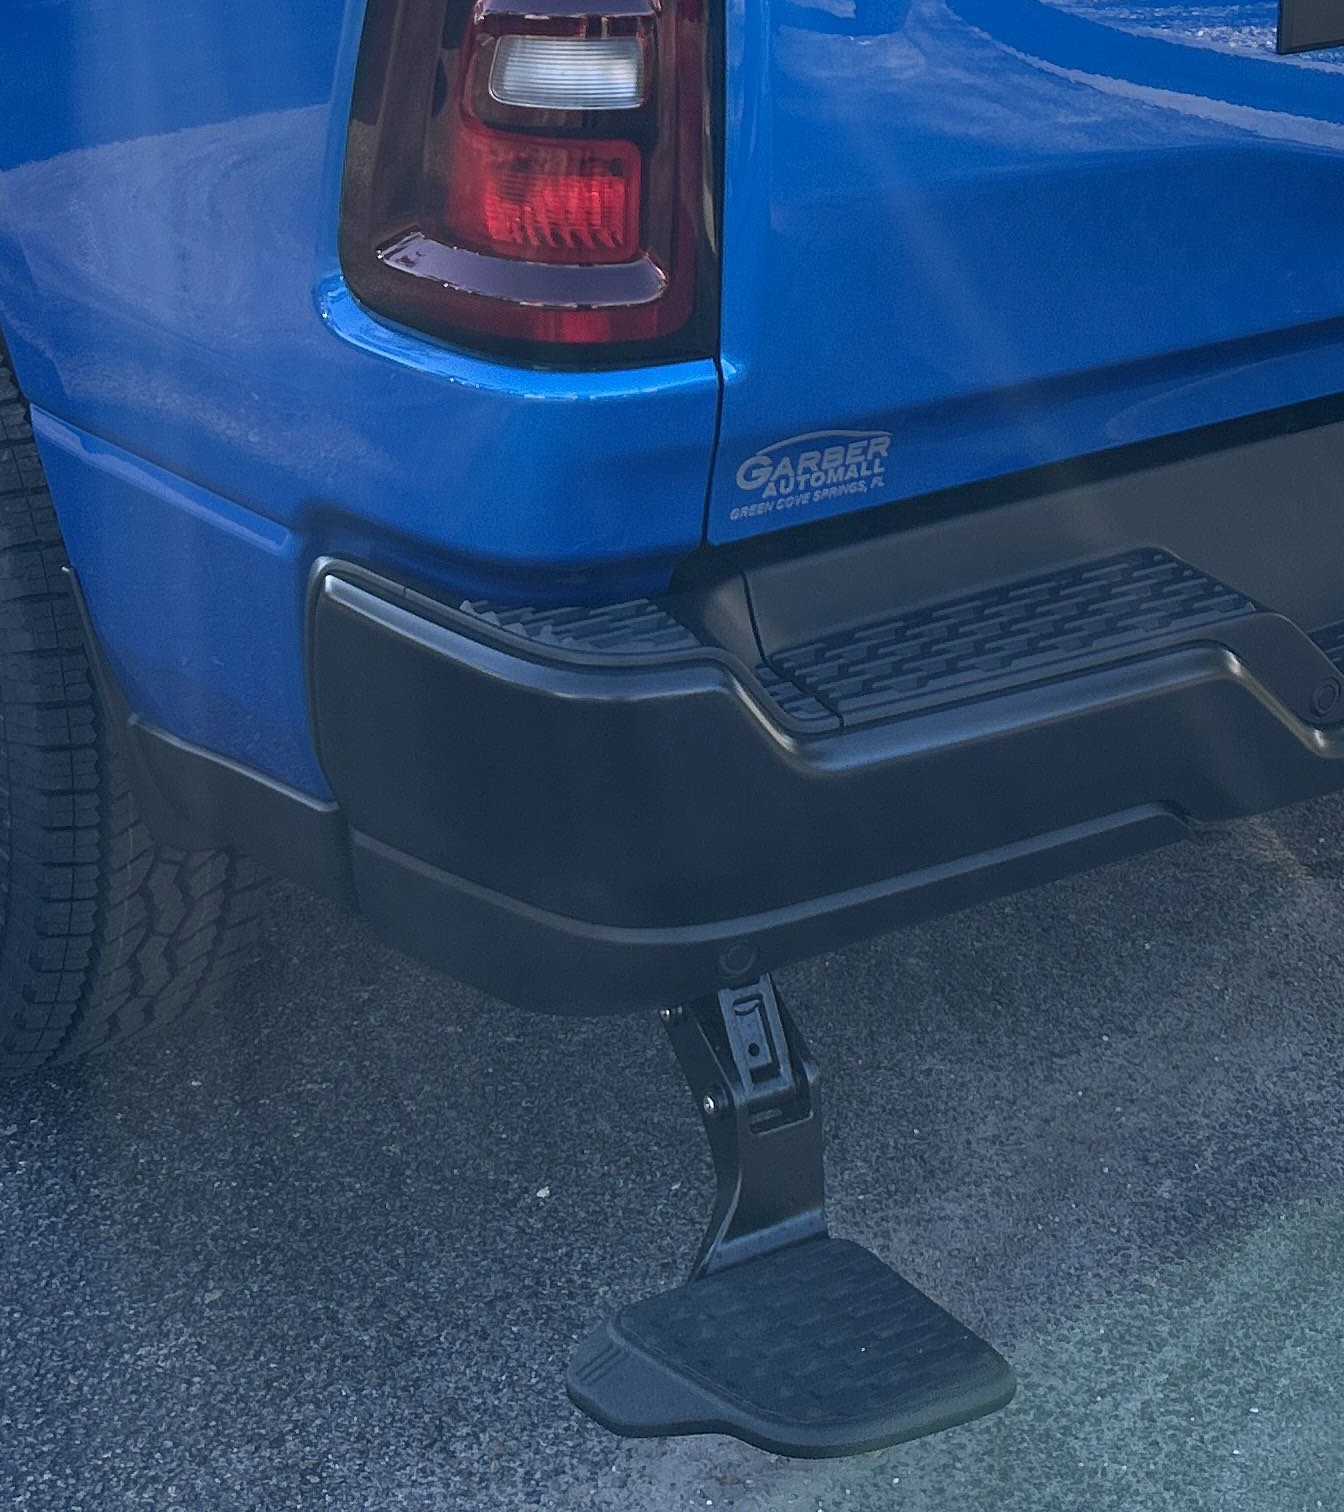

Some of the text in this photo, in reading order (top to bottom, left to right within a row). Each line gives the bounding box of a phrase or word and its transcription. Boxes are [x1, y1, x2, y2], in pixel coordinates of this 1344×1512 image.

[735, 436, 892, 491] GARBER
[761, 458, 886, 499] AUTOMALL
[730, 500, 776, 521] GREEN
[775, 492, 811, 511] COVE
